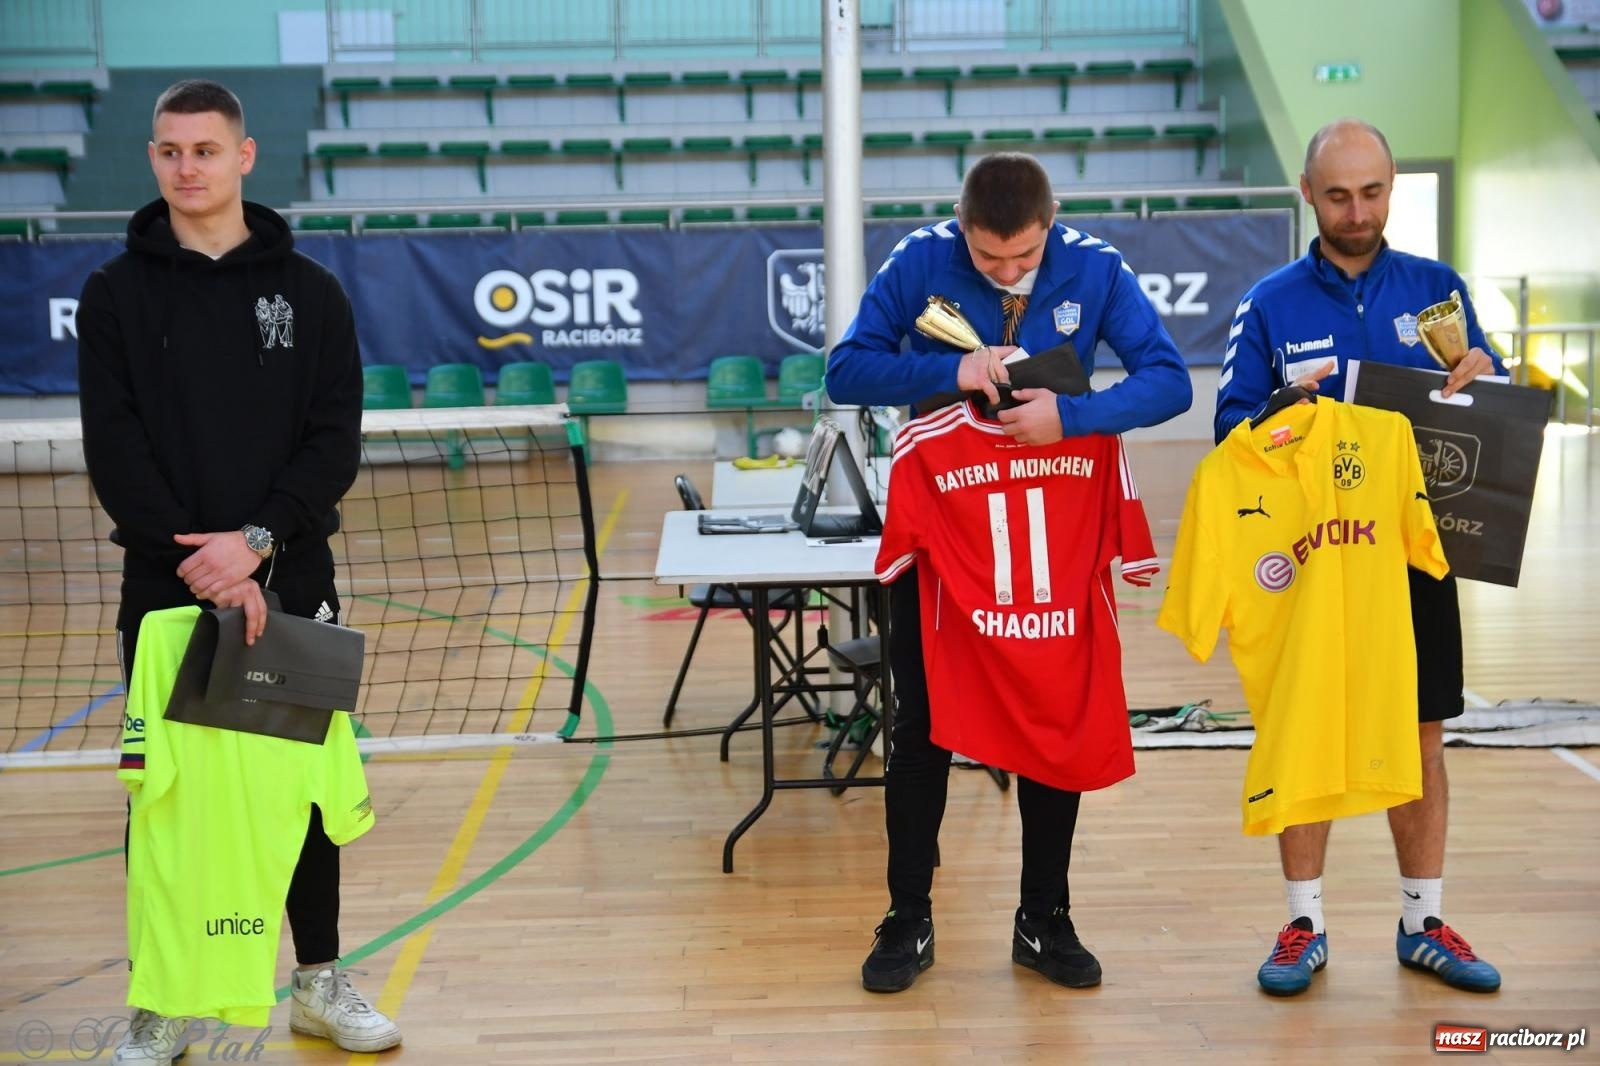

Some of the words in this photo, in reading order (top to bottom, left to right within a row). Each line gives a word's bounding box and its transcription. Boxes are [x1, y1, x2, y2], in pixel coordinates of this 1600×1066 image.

[1137, 271, 1209, 316] RZ
[48, 297, 80, 341] R
[541, 324, 643, 347] RACIBÓRZ
[1286, 334, 1334, 355] hummel
[935, 462, 1000, 493] BAYERN
[1010, 456, 1094, 479] MÜNCHEN
[1334, 457, 1362, 480] BVB
[1341, 478, 1352, 487] 09
[1434, 512, 1484, 536] ÓRZ
[987, 487, 1052, 606] 11
[971, 608, 1075, 640] SHAQIRI
[126, 713, 145, 732] be
[206, 912, 264, 936] unice
